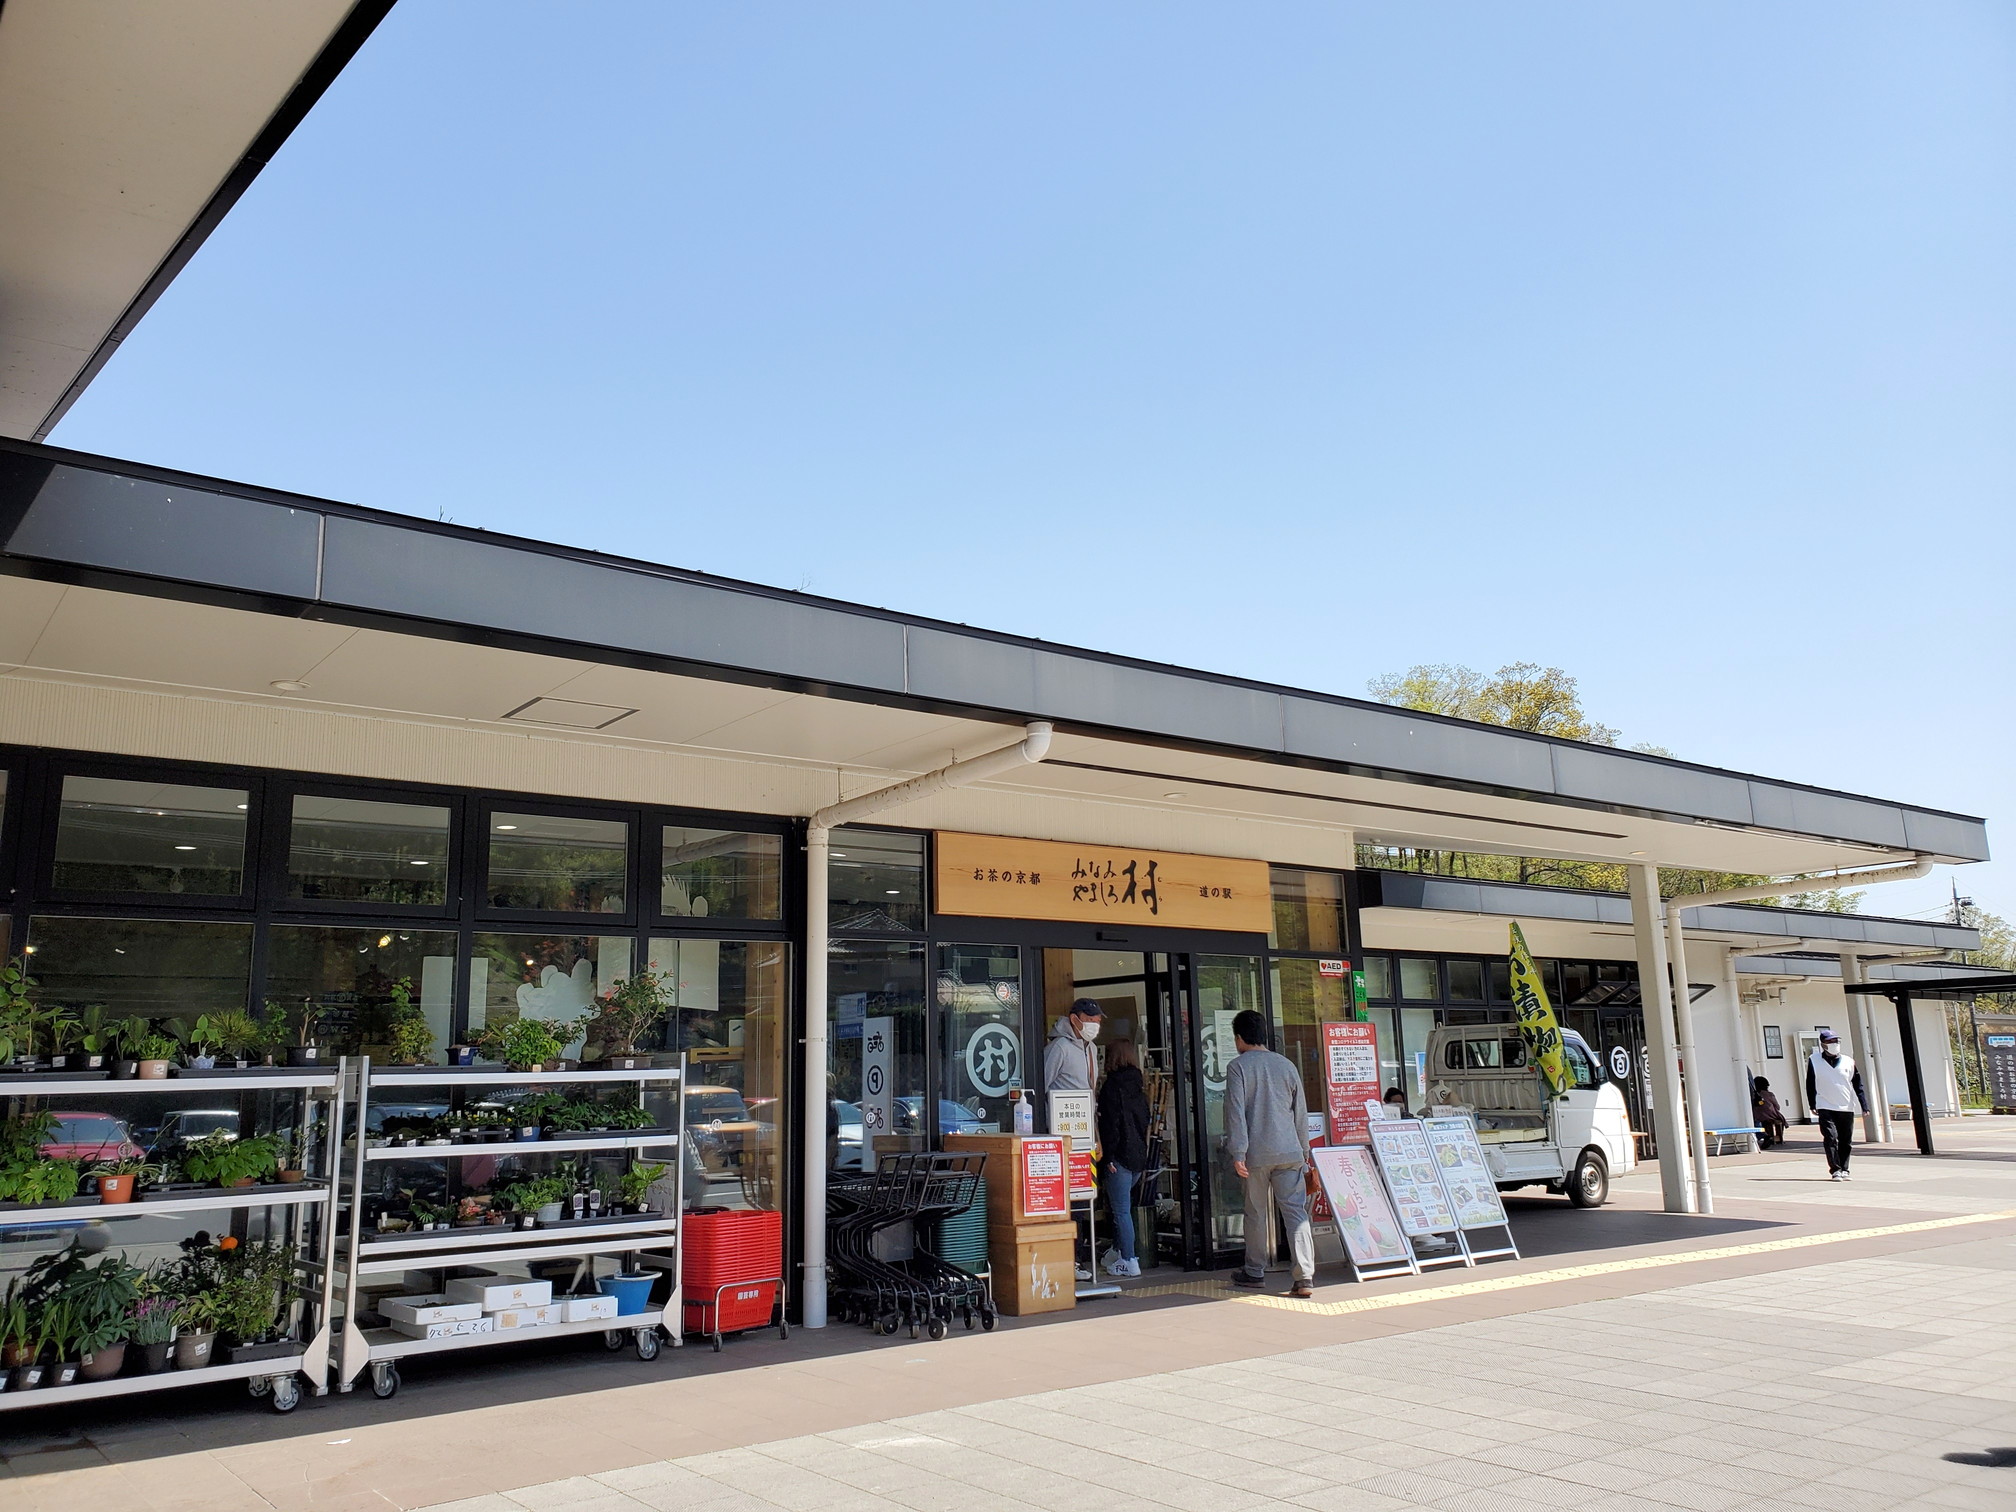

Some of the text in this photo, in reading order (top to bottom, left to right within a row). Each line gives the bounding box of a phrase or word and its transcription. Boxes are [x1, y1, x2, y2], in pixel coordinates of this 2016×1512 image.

[973, 867, 1041, 886] お茶の京都
[1071, 858, 1117, 879] みなみ
[1072, 882, 1118, 906] やましろ
[1199, 885, 1233, 900] 道の駅
[1328, 1027, 1370, 1037] お客様にお願い
[975, 1038, 1013, 1082] 村
[1338, 1156, 1368, 1218] 春いちご
